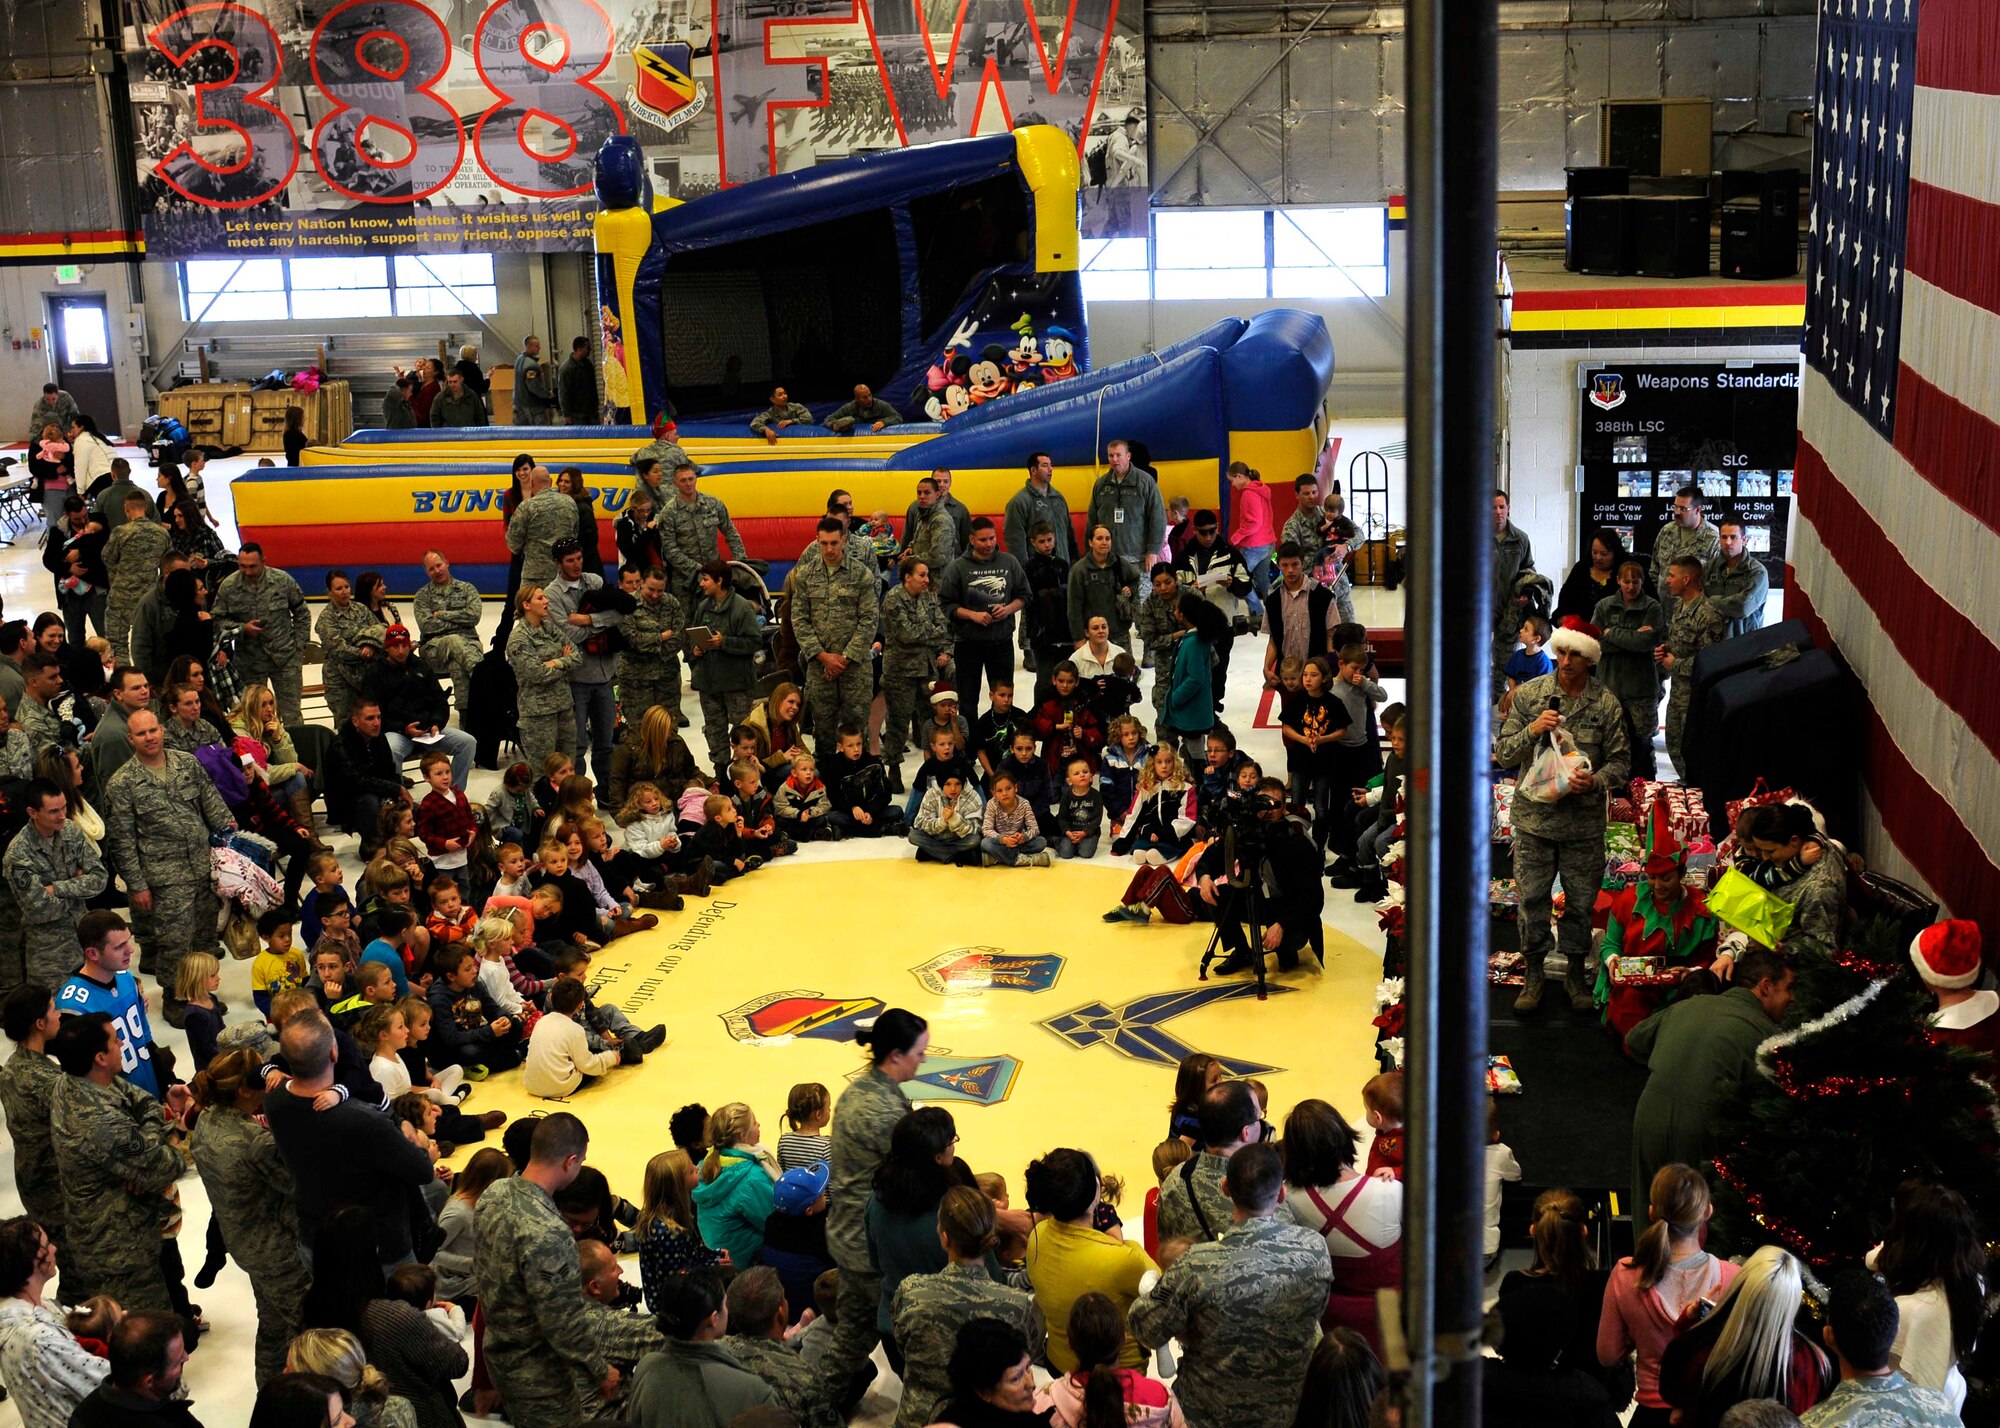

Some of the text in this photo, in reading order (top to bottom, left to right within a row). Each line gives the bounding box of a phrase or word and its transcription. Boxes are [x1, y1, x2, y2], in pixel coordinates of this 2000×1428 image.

[711, 0, 1120, 189] FW
[148, 0, 628, 208] 388
[630, 98, 704, 127] LIBERTAS VEL MORS
[454, 181, 492, 189] OPERATION
[226, 220, 251, 232] Let
[254, 221, 294, 232] every
[298, 217, 346, 230] Nation
[350, 216, 393, 229] know,
[396, 213, 458, 227] whether
[462, 213, 473, 225] it
[477, 212, 528, 224] wishes
[532, 213, 548, 222] us
[551, 210, 581, 221] well
[227, 236, 266, 247] meet
[269, 237, 294, 248] any
[298, 234, 367, 246] hardship,
[372, 230, 429, 244] support
[434, 232, 460, 243] any
[464, 228, 513, 240] friend,
[516, 229, 568, 240] oppose
[1637, 374, 1709, 391] Weapons
[1595, 421, 1665, 432] 388th LSC
[1722, 454, 1748, 466] SLC
[1594, 503, 1641, 511] Load Crew
[1734, 502, 1774, 511] Hot Shot
[1593, 512, 1642, 520] of the Year
[1658, 512, 1668, 520] of
[1742, 512, 1765, 520] Crew
[620, 900, 738, 1014] Defending our nation
[61, 984, 89, 1004] 89
[111, 1004, 150, 1074] 89
